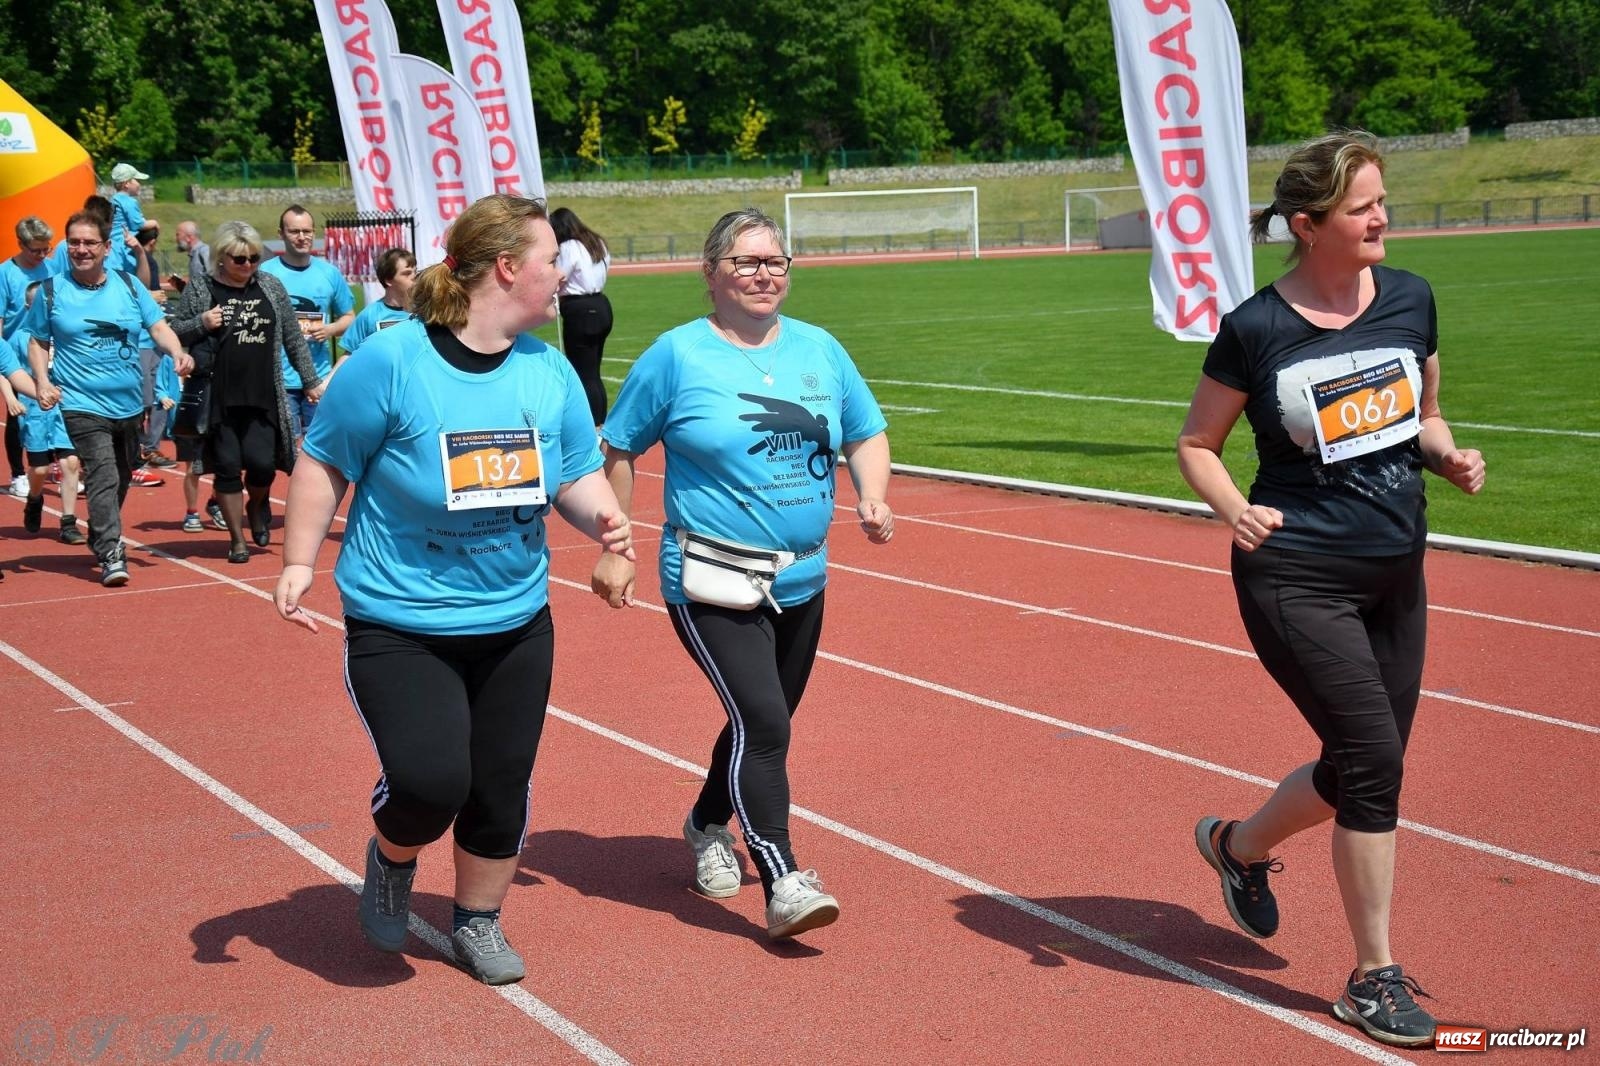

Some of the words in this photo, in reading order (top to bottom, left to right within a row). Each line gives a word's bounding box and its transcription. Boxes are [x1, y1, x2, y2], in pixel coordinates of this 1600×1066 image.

[1340, 389, 1401, 430] 062
[765, 432, 802, 454] VIII
[766, 454, 804, 463] RACIBORSKI
[472, 452, 522, 482] 132
[786, 472, 807, 480] BARIER
[776, 496, 814, 508] Racibórz
[470, 542, 512, 555] Racibórz
